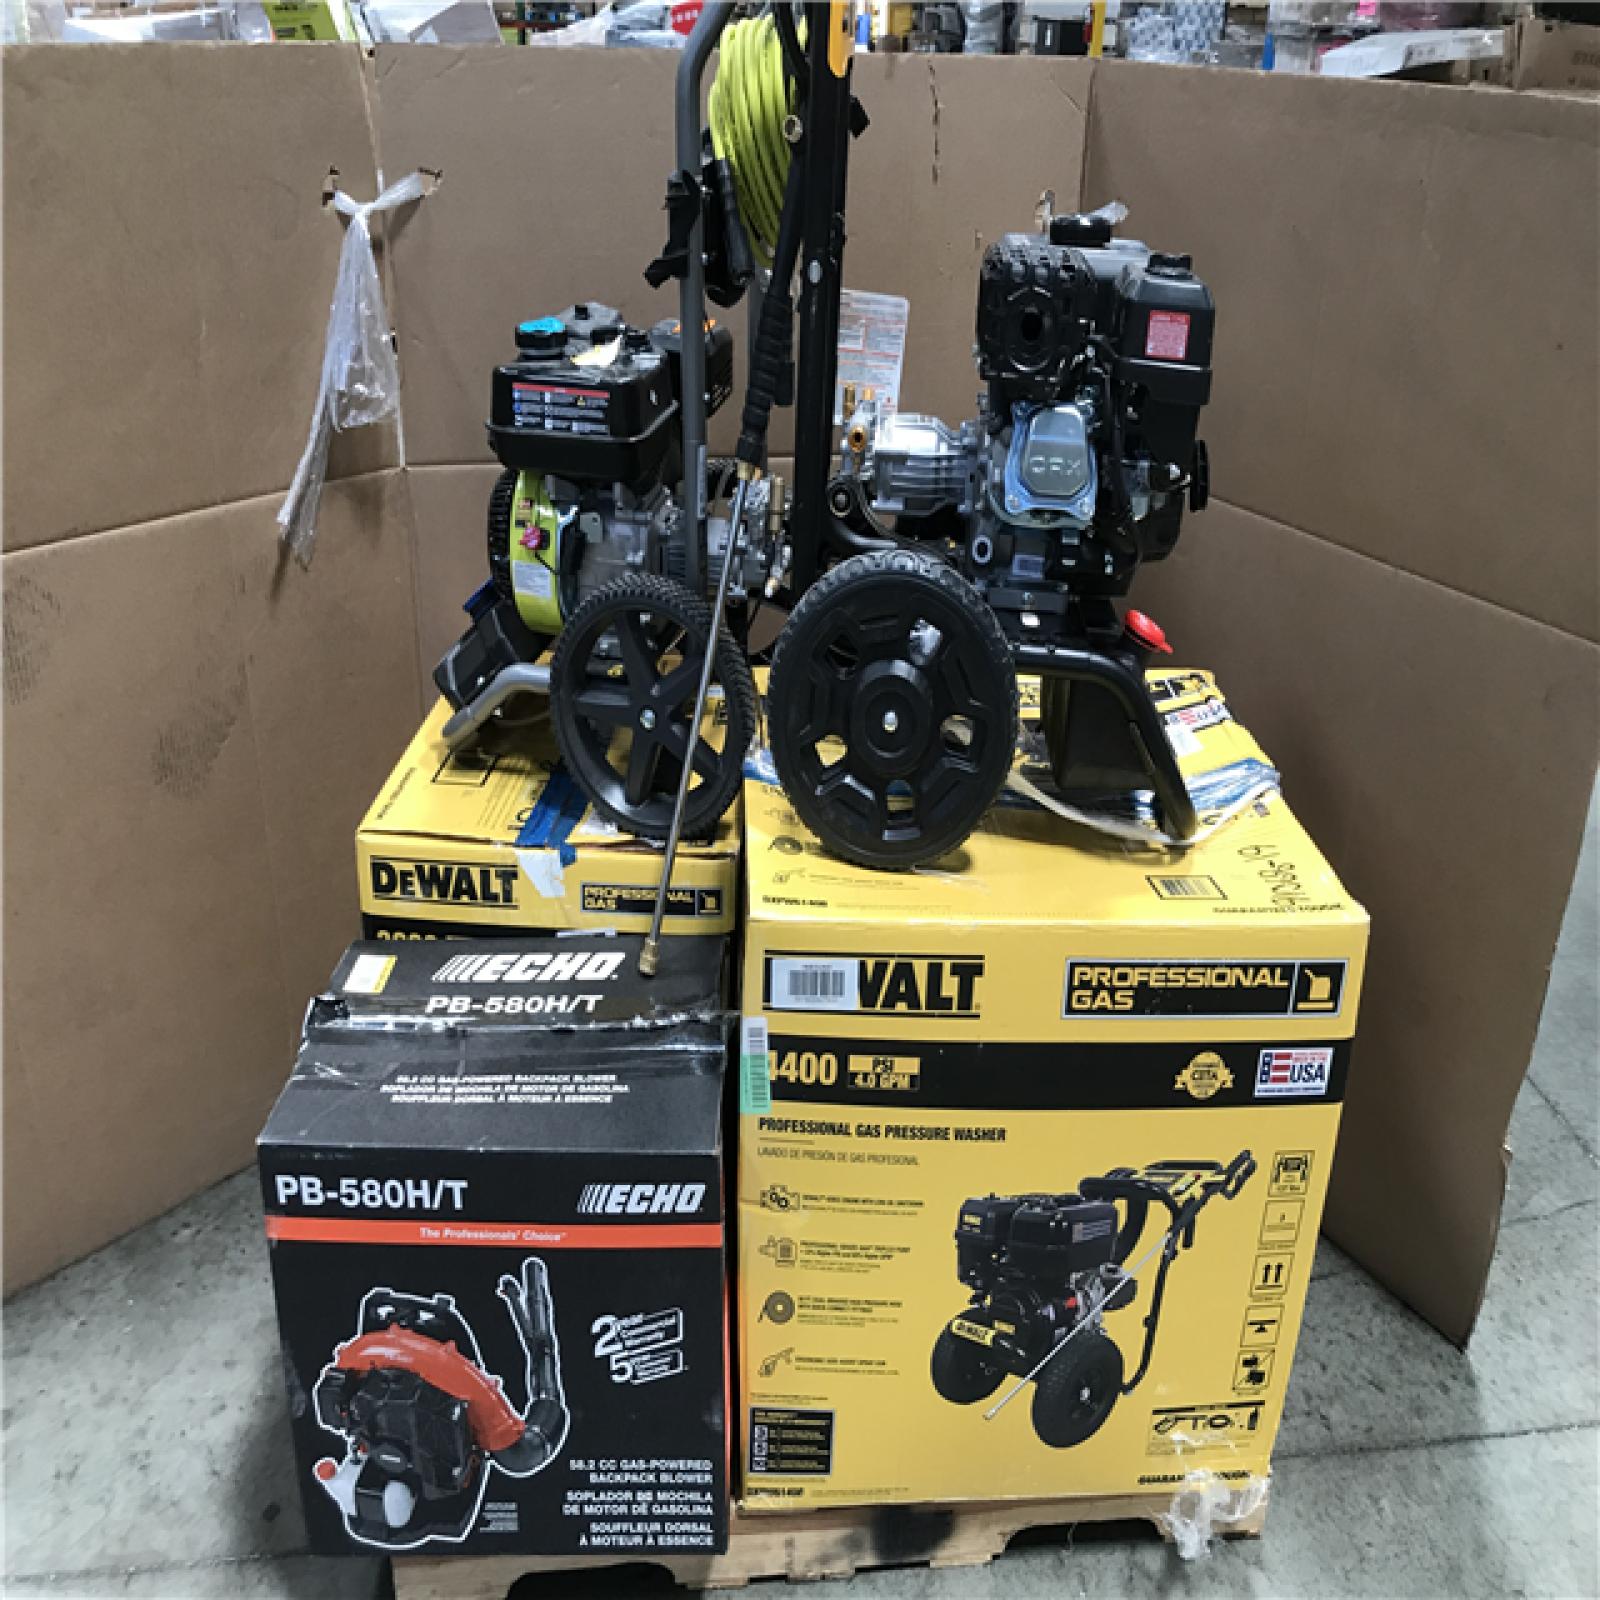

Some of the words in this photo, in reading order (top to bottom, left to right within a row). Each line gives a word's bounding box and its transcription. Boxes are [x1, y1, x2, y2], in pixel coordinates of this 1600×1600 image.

[480, 952, 625, 982] ECHO
[1073, 966, 1289, 988] PROFESSIONAL
[425, 994, 602, 1014] PB-580H/T
[1071, 989, 1135, 1010] GAS
[1290, 1063, 1326, 1083] USA
[759, 1117, 851, 1136] PROFESSIONAL
[855, 1123, 881, 1138] GAS
[885, 1125, 950, 1141] PRESSURE
[954, 1127, 1006, 1142] WASHER
[275, 1175, 468, 1210] PB-580H/T
[598, 1184, 705, 1214] ECHO
[420, 1227, 440, 1239] The
[592, 1315, 623, 1357] 2
[610, 1354, 632, 1383] 5
[620, 1459, 713, 1471] GAS-POWERED
[590, 1472, 656, 1483] BACKPACK
[660, 1472, 713, 1483] BLOWER
[567, 1490, 632, 1501] SOPLADOR
[636, 1490, 653, 1501] DE
[657, 1490, 713, 1501] MOCHILA
[563, 1504, 580, 1516] DE
[584, 1504, 628, 1516] MOTOR
[632, 1504, 648, 1516] DE
[652, 1504, 713, 1516] GASOLINA
[664, 1522, 712, 1533] DORSAL
[592, 1534, 643, 1546] MOTEUR
[657, 1534, 713, 1546] ESSENCE
